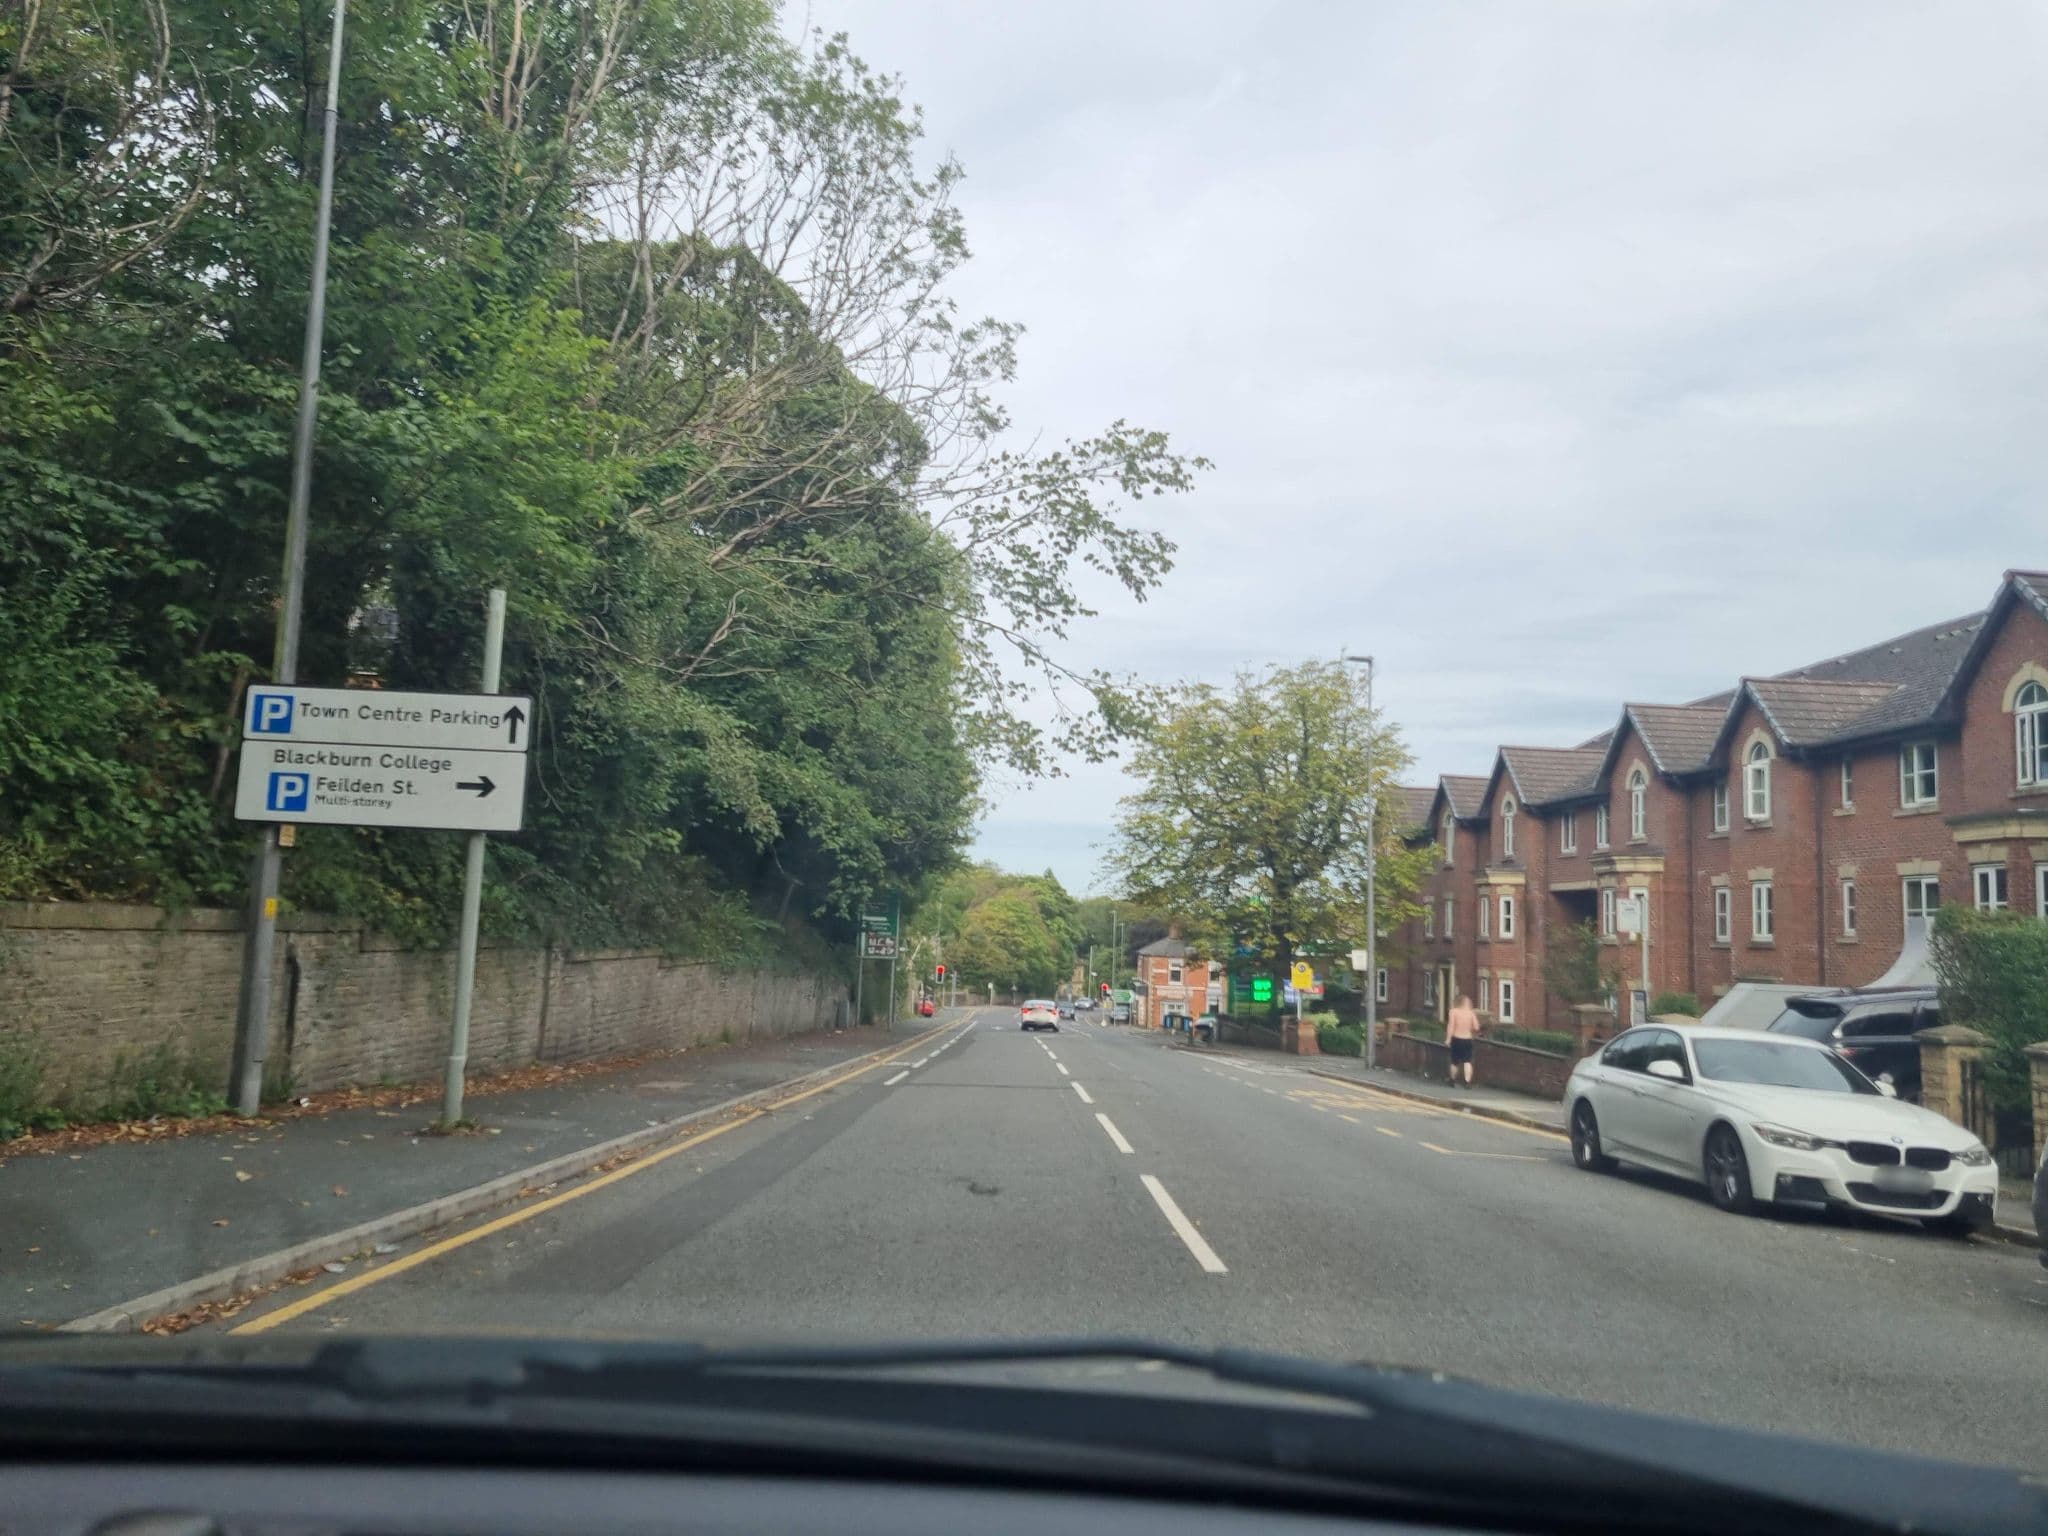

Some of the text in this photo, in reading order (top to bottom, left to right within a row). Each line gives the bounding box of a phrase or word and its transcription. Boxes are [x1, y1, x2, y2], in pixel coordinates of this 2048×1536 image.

[261, 698, 289, 730] P
[300, 703, 500, 728] Town Centre Parking
[273, 749, 452, 773] Blackburn College
[276, 775, 304, 809] P
[316, 777, 418, 794] Feilden St.
[315, 796, 392, 808] Multi-storey
